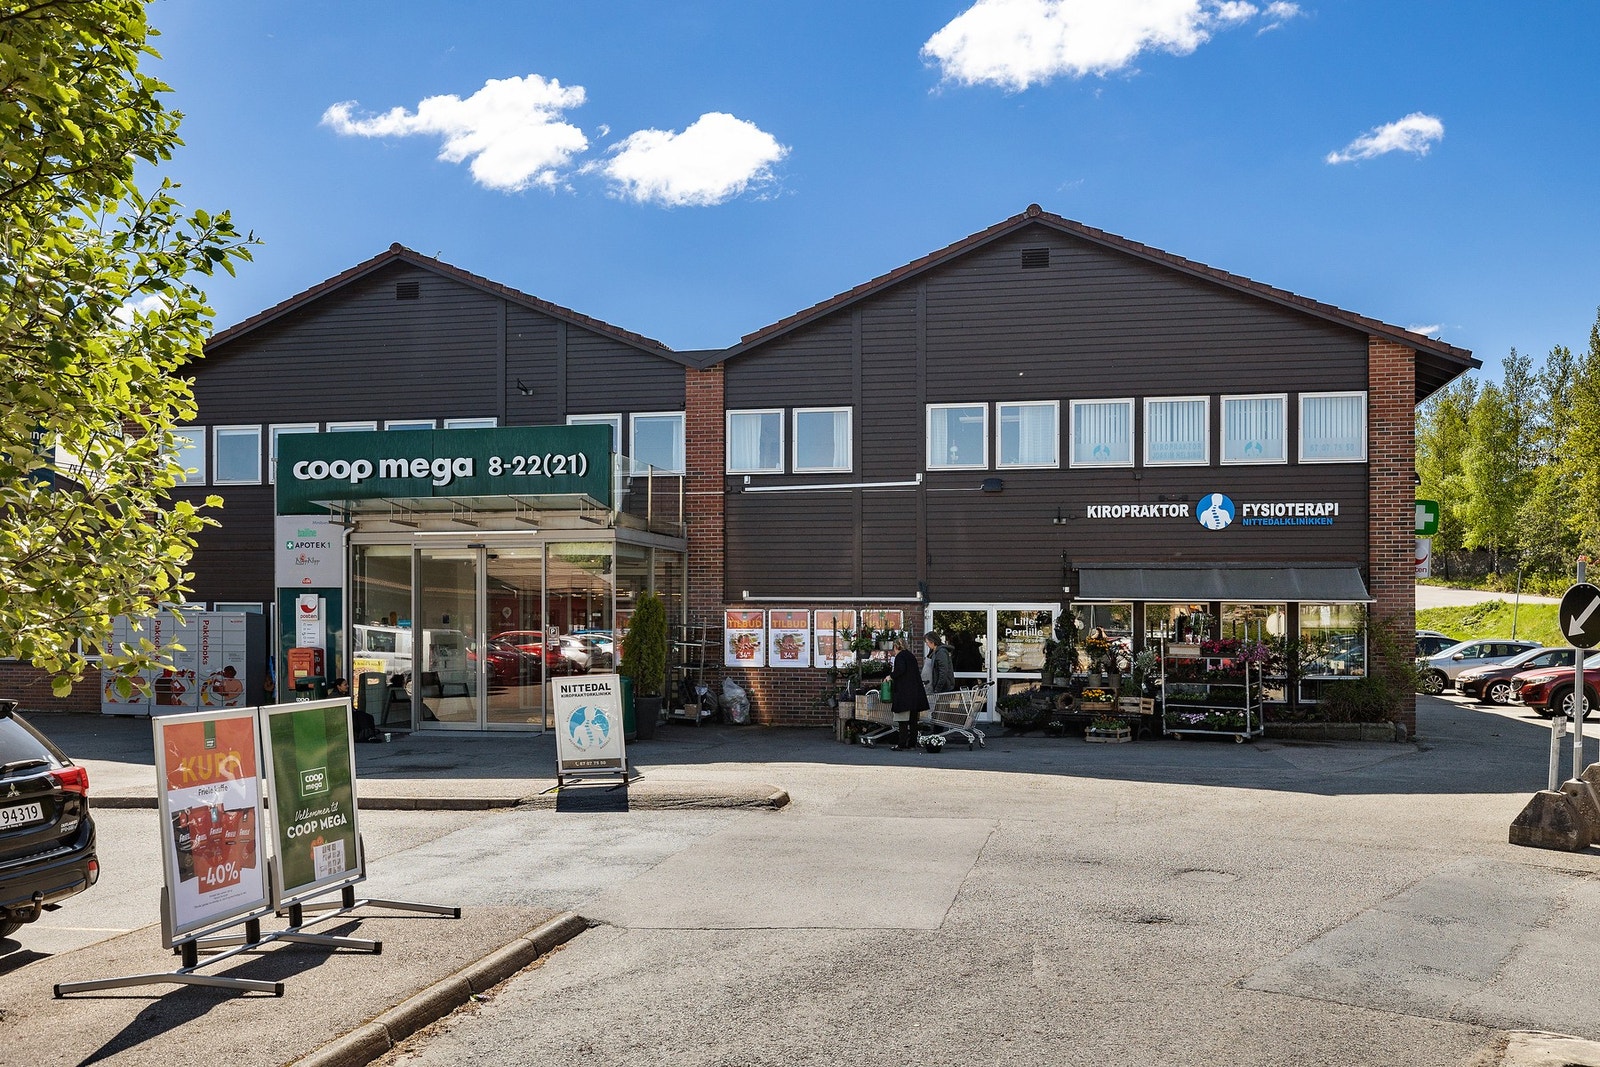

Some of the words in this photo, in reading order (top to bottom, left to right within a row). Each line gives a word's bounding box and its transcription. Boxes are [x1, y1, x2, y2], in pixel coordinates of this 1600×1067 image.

[293, 459, 373, 483] coop
[379, 457, 473, 486] mega
[488, 452, 588, 477] 8-22(21)
[1087, 504, 1189, 518] KIROPRAKTOR
[1242, 503, 1339, 517] FYSIOTERAPI
[1242, 518, 1333, 526] NITTEDALKLINIKKEN
[728, 620, 762, 628] TILBUD
[772, 620, 806, 628] TILBUD
[1014, 617, 1034, 625] Lille
[1005, 628, 1043, 636] Pernille
[560, 683, 612, 693] NITTEDAL
[181, 750, 241, 783] KUPP
[304, 773, 324, 783] coop
[306, 781, 322, 791] mega
[2, 805, 38, 824] 94319
[294, 808, 330, 822] Velkommen
[330, 801, 339, 812] til
[287, 820, 318, 838] COOP
[320, 813, 347, 830] MEGA
[200, 861, 239, 885] -40%
